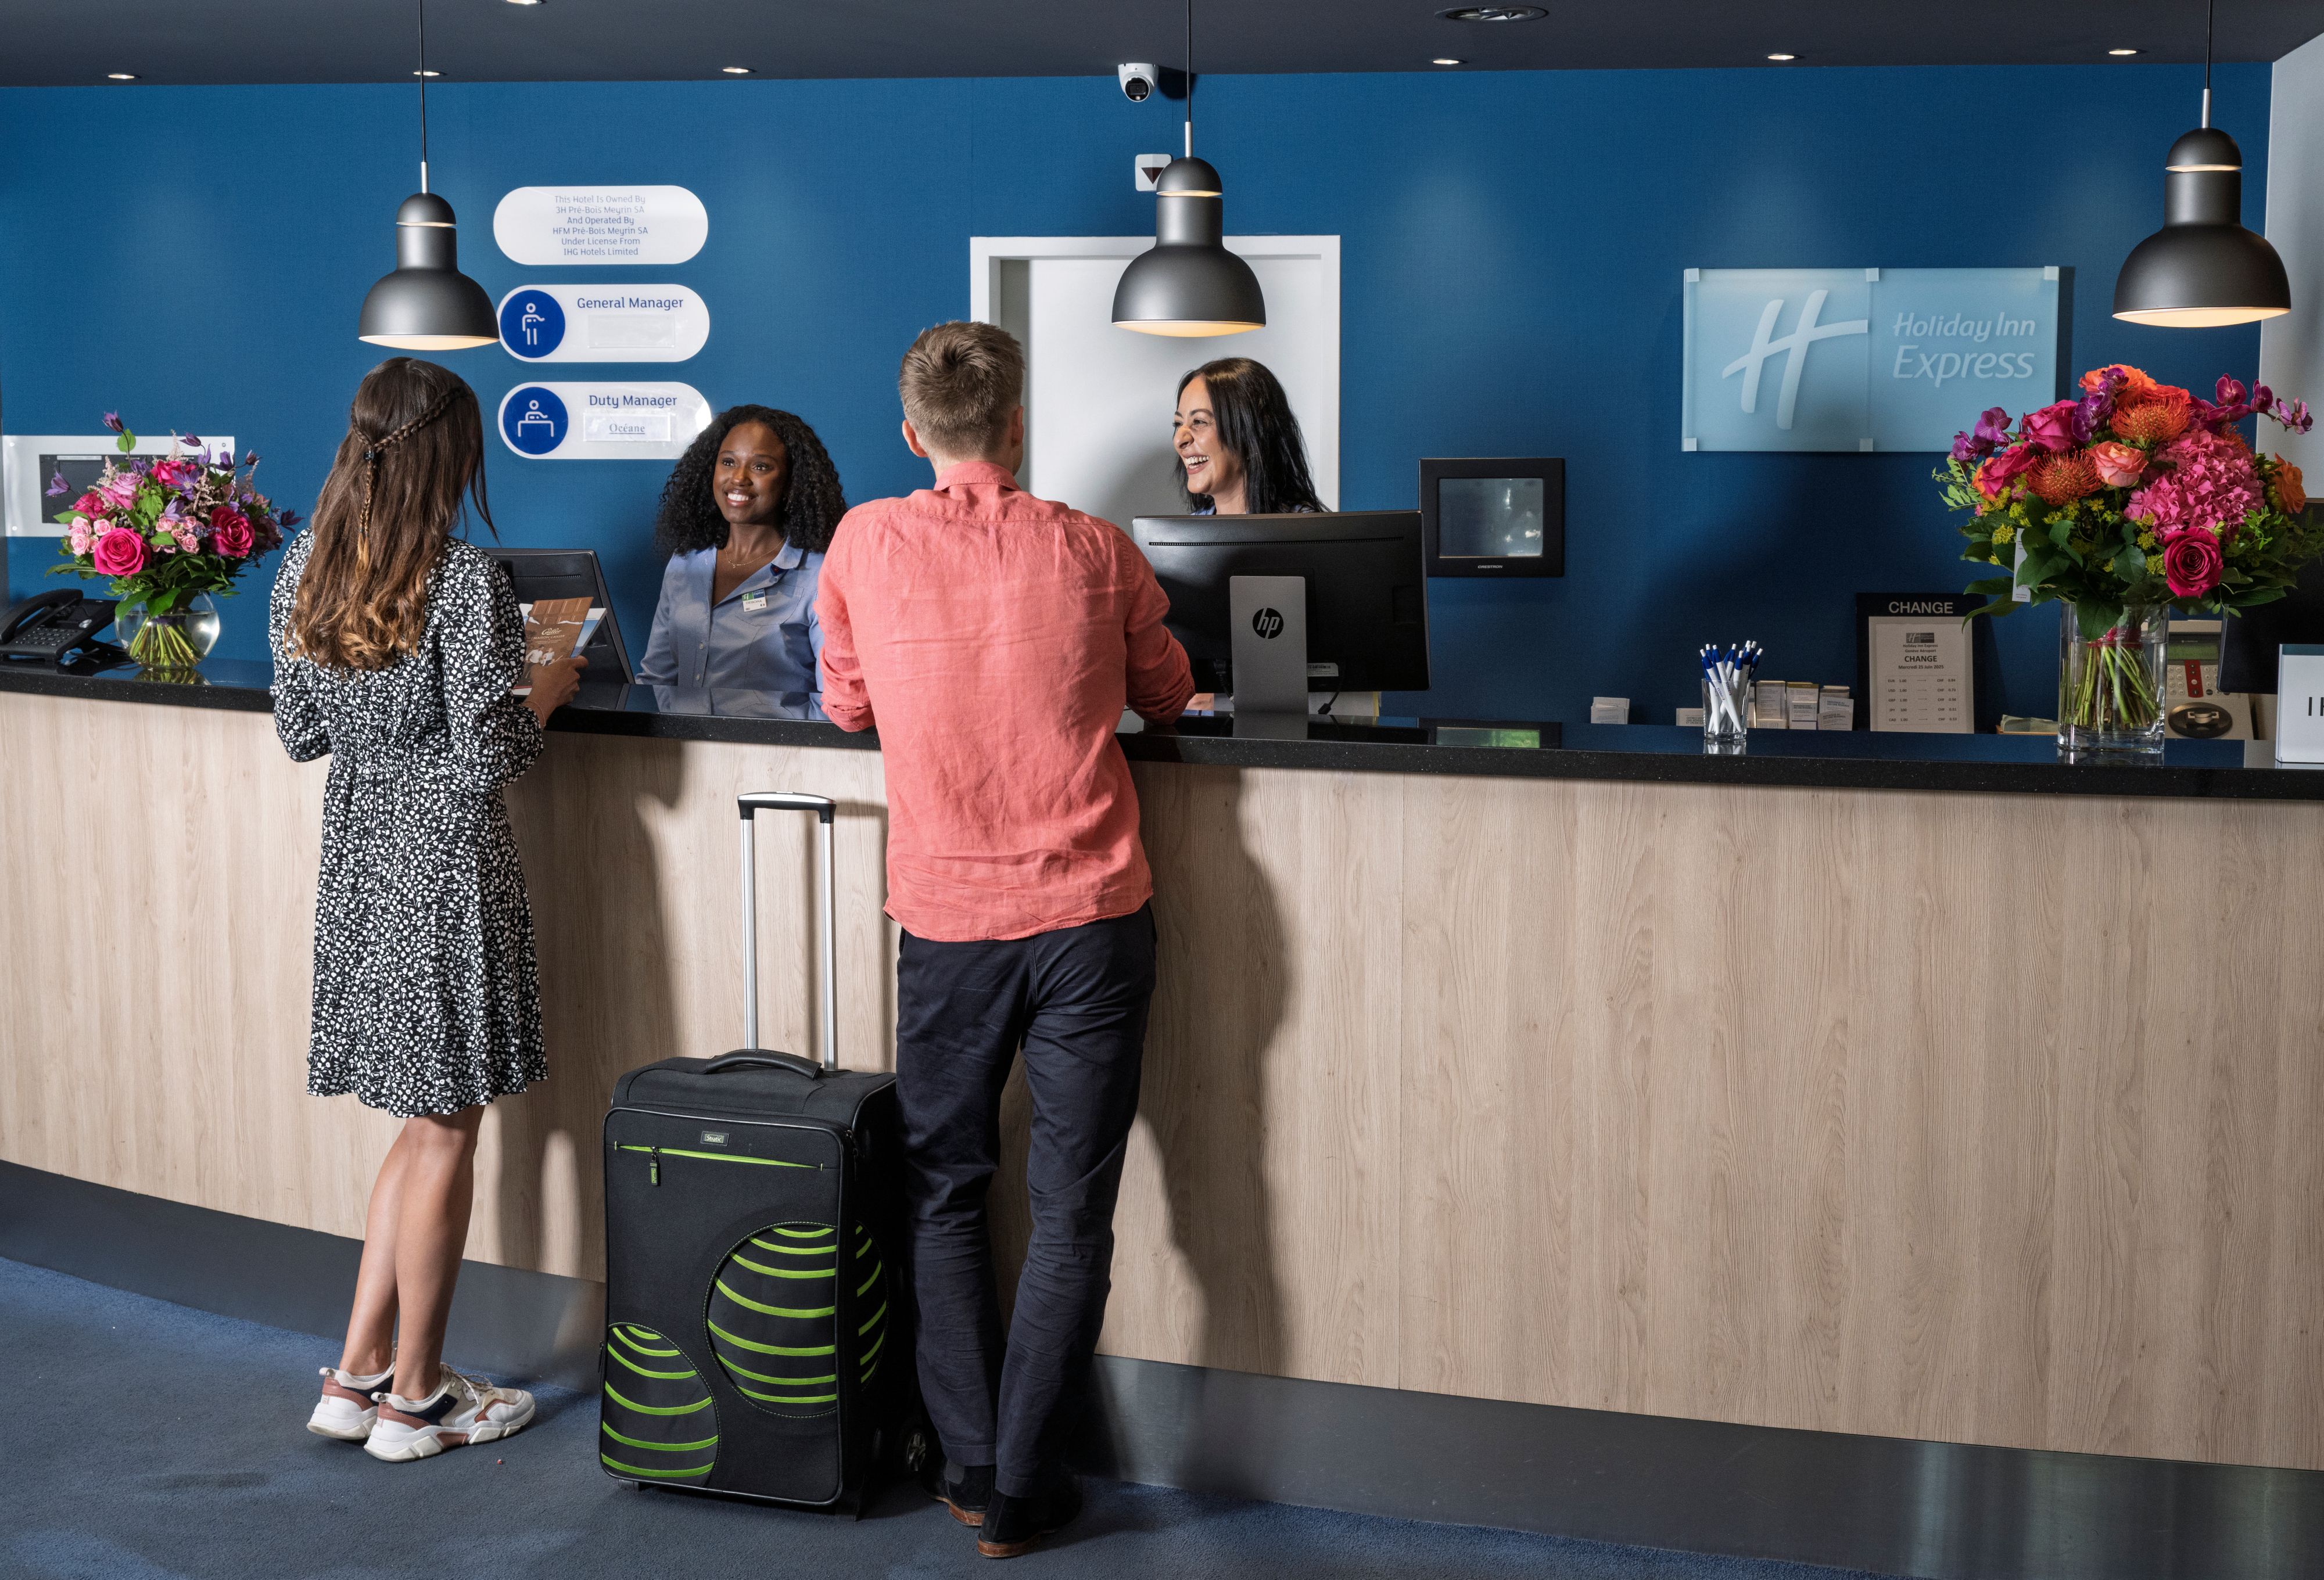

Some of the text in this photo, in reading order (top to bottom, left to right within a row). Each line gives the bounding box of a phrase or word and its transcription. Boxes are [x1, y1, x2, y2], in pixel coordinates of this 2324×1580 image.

[635, 196, 645, 204] By
[604, 206, 632, 214] Meyrin
[585, 217, 621, 225] Operated
[624, 217, 634, 225] By
[608, 227, 635, 236] Meyrin
[577, 297, 684, 311] General Manager
[1892, 311, 2036, 343] Holiday Inn
[1892, 344, 2035, 389] Express
[589, 395, 677, 409] Duty Manager
[609, 423, 645, 433] Océane
[1888, 601, 1953, 614] CHANGE
[1256, 608, 1281, 639] hp
[541, 627, 562, 636] Cailler
[2308, 696, 2324, 716] I
[706, 1134, 722, 1142] Stratic
